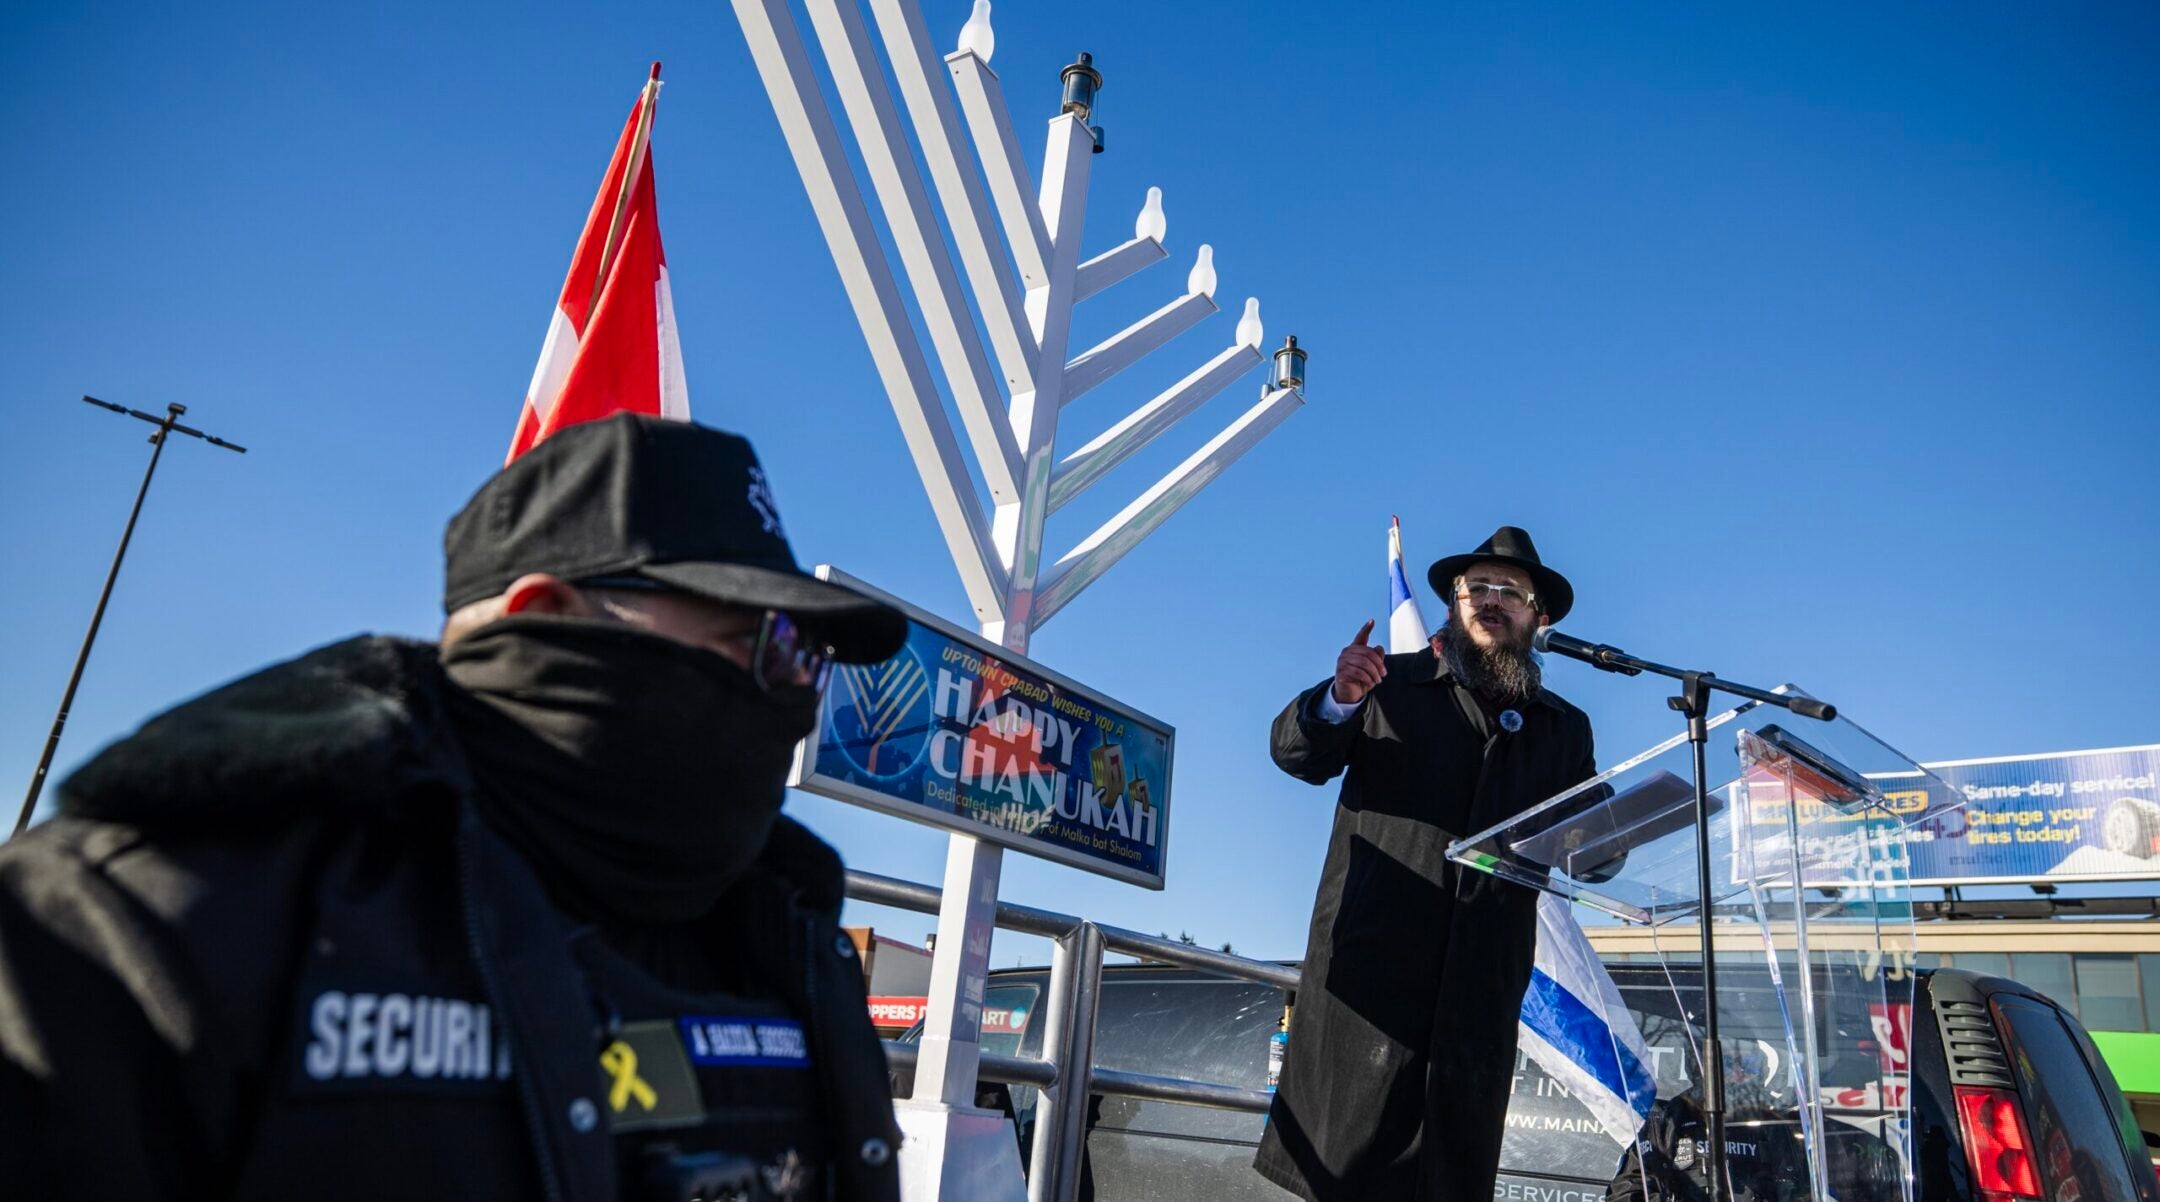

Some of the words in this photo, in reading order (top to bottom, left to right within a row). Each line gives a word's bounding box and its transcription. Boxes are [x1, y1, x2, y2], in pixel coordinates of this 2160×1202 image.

[934, 667, 1082, 766] HAPPY
[942, 646, 997, 681] UPTOWN
[1001, 673, 1049, 702] CHABAD
[1052, 694, 1092, 722] WISHES
[1095, 713, 1115, 732] YOU
[1115, 724, 1125, 737] A
[927, 781, 987, 812] Dedicated
[1048, 822, 1060, 836] of
[1060, 824, 1090, 845] Malka
[1092, 833, 1109, 850] bat
[1109, 839, 1143, 861] Shalom
[929, 729, 1158, 847] CHANUKAH
[1962, 780, 2065, 800] Same-day
[2070, 772, 2157, 794] service!
[1965, 809, 2044, 827] Change
[2048, 807, 2098, 825] your
[2016, 825, 2081, 844] today!
[305, 989, 512, 1081] SECURI
[868, 1004, 917, 1020] PPERS
